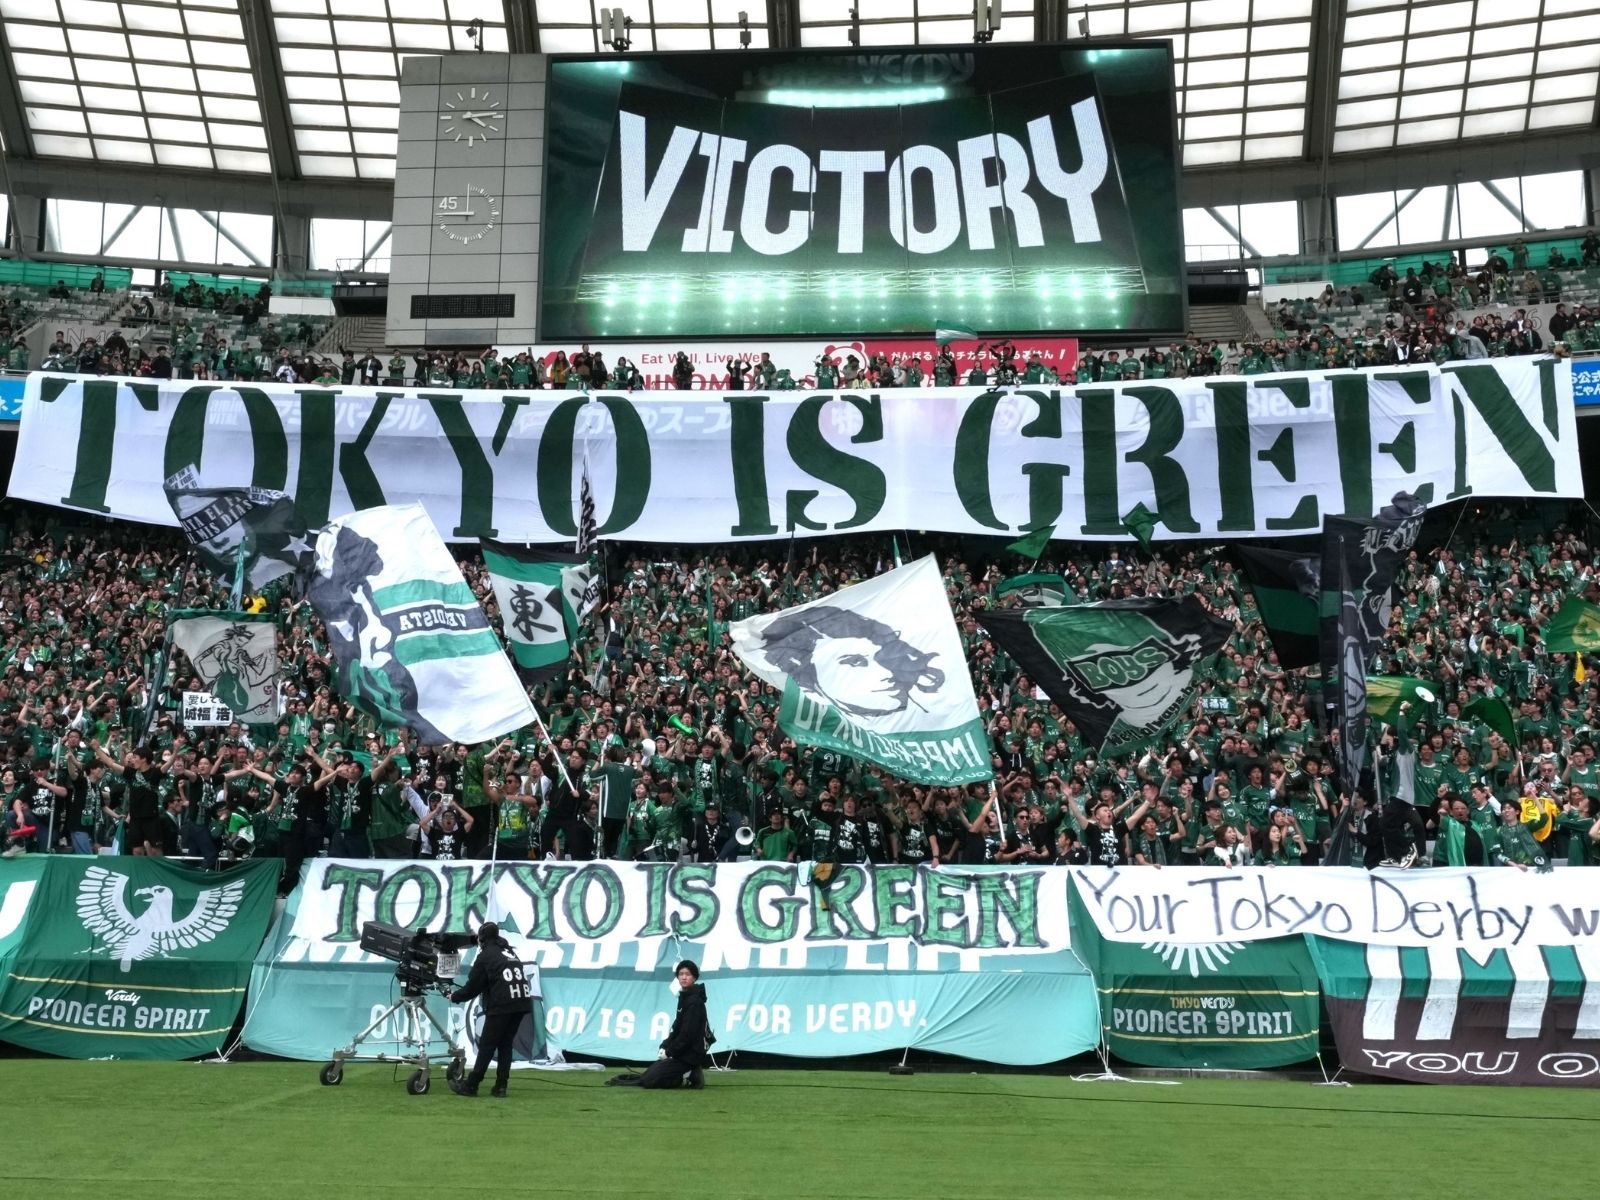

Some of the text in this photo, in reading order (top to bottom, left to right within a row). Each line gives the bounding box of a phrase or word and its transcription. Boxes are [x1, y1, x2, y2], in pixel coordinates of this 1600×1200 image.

[618, 95, 1110, 255] VICTORY
[439, 196, 458, 210] 45
[641, 353, 663, 364] Eat
[668, 353, 701, 364] Wll,
[706, 353, 733, 363] Live
[40, 376, 652, 538] TOKYO
[723, 393, 887, 537] IS
[953, 357, 1563, 536] GREEN
[220, 498, 254, 527] DIAS
[509, 583, 558, 642] 東
[1074, 646, 1170, 690] BOYS
[321, 862, 1049, 949] TOKYO IS GREEN
[1076, 869, 1189, 935] Your
[1187, 874, 1353, 936] Tokyo
[1370, 874, 1533, 946] Derby
[502, 967, 529, 982] 03
[28, 996, 211, 1030] PIONEER SPIRIT
[599, 1007, 634, 1039] IS
[725, 1003, 792, 1034] FOR
[805, 1000, 929, 1034] VERDY.
[1113, 1007, 1292, 1035] PIONEER SPIRIT
[1362, 1049, 1600, 1078] YOU O
